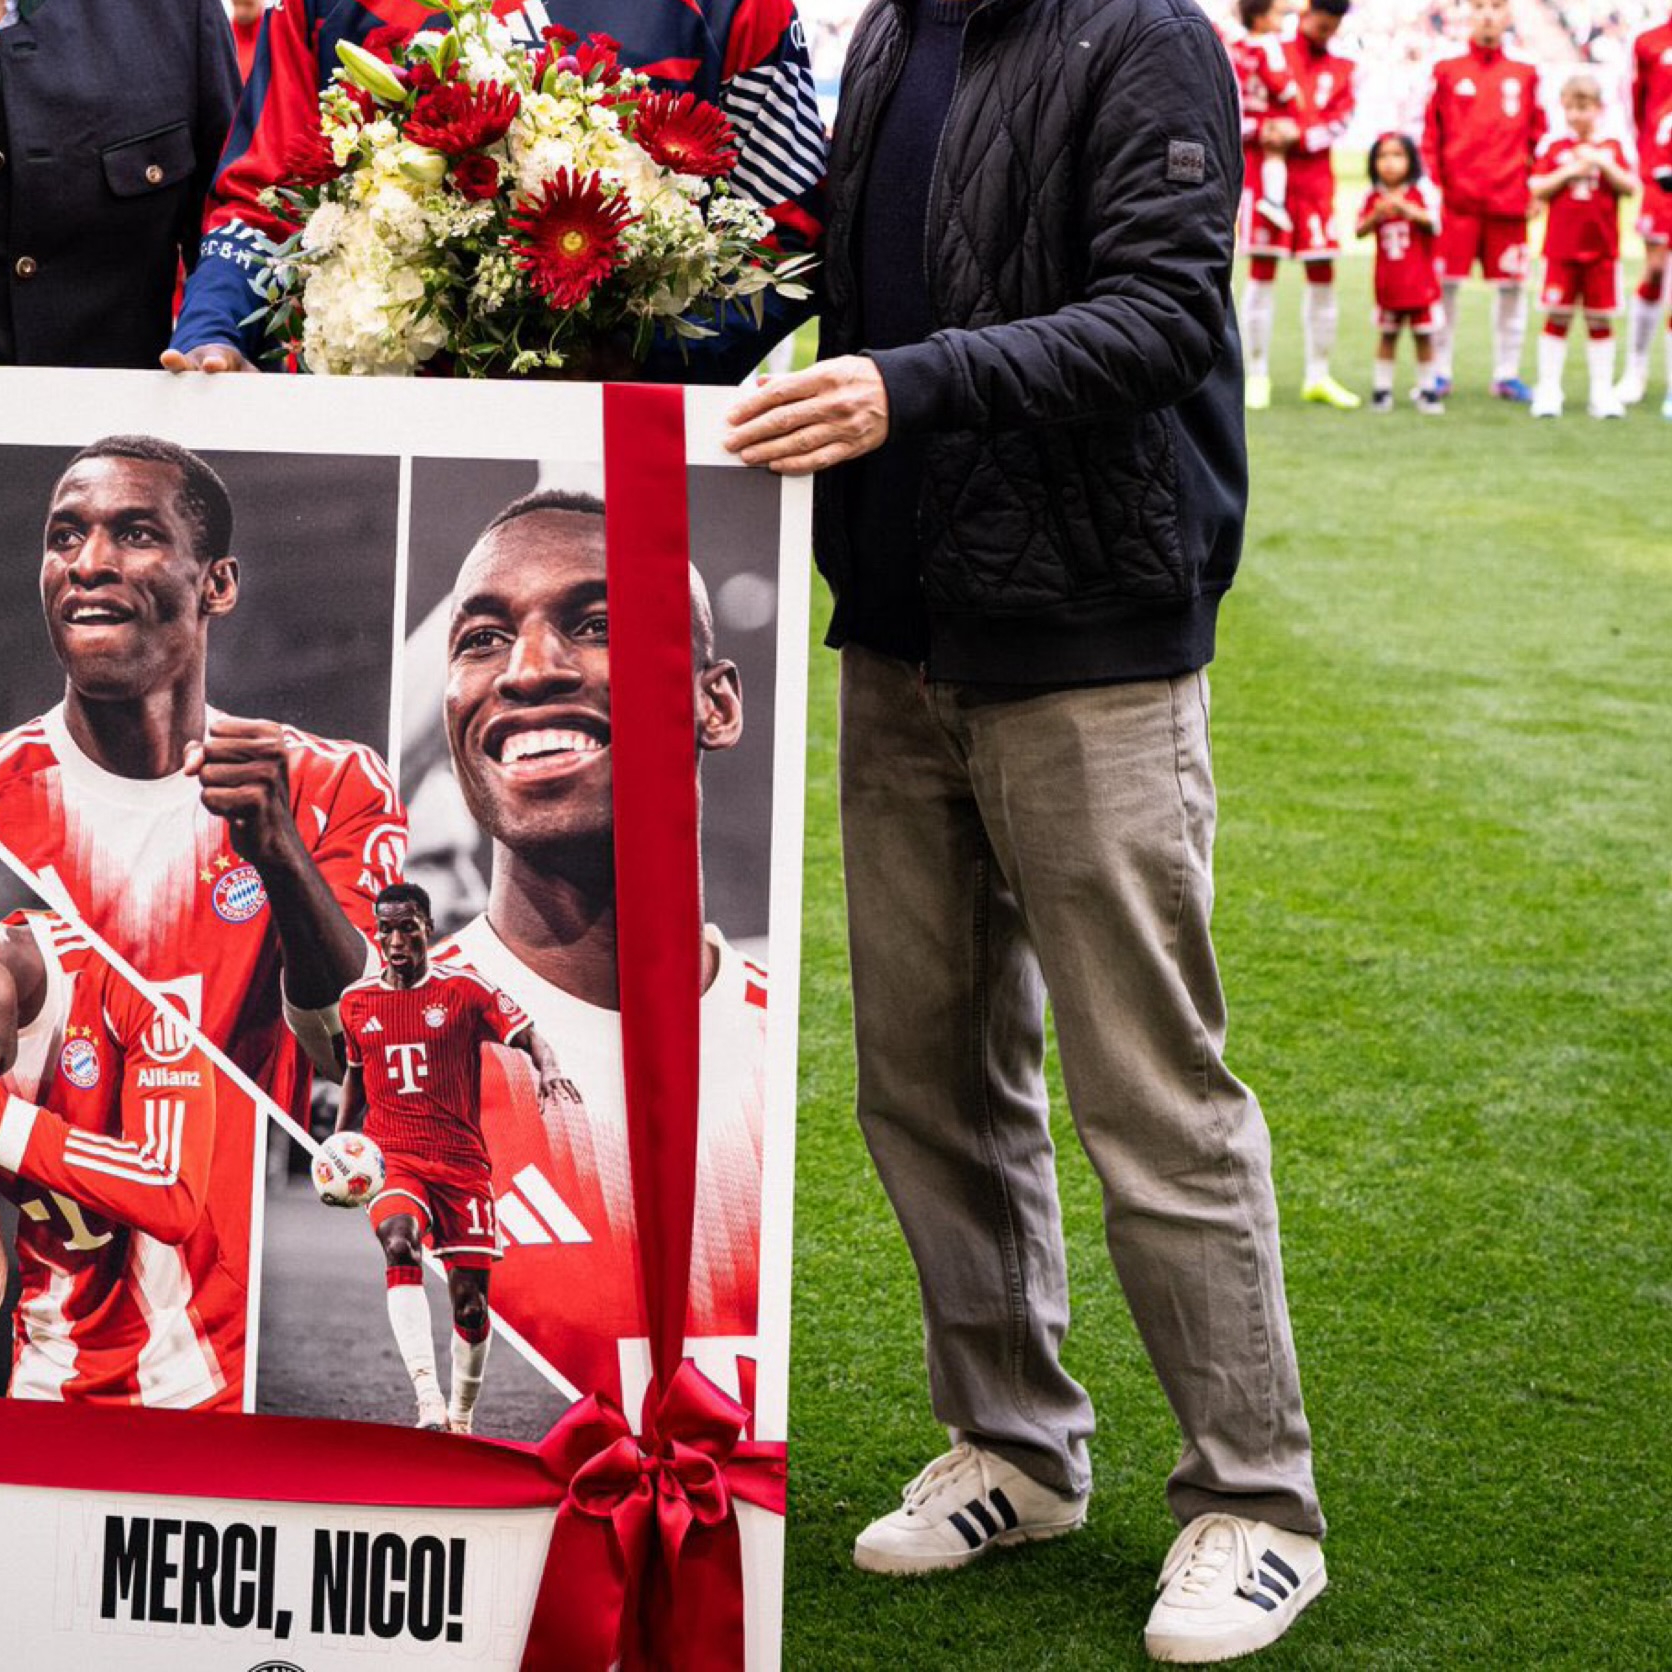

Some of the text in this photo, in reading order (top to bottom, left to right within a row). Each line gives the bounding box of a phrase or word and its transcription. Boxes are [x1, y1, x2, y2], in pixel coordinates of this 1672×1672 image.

[137, 1067, 201, 1087] Allianz
[385, 1042, 429, 1095] T
[100, 1514, 467, 1643] MERCI, NICO!
